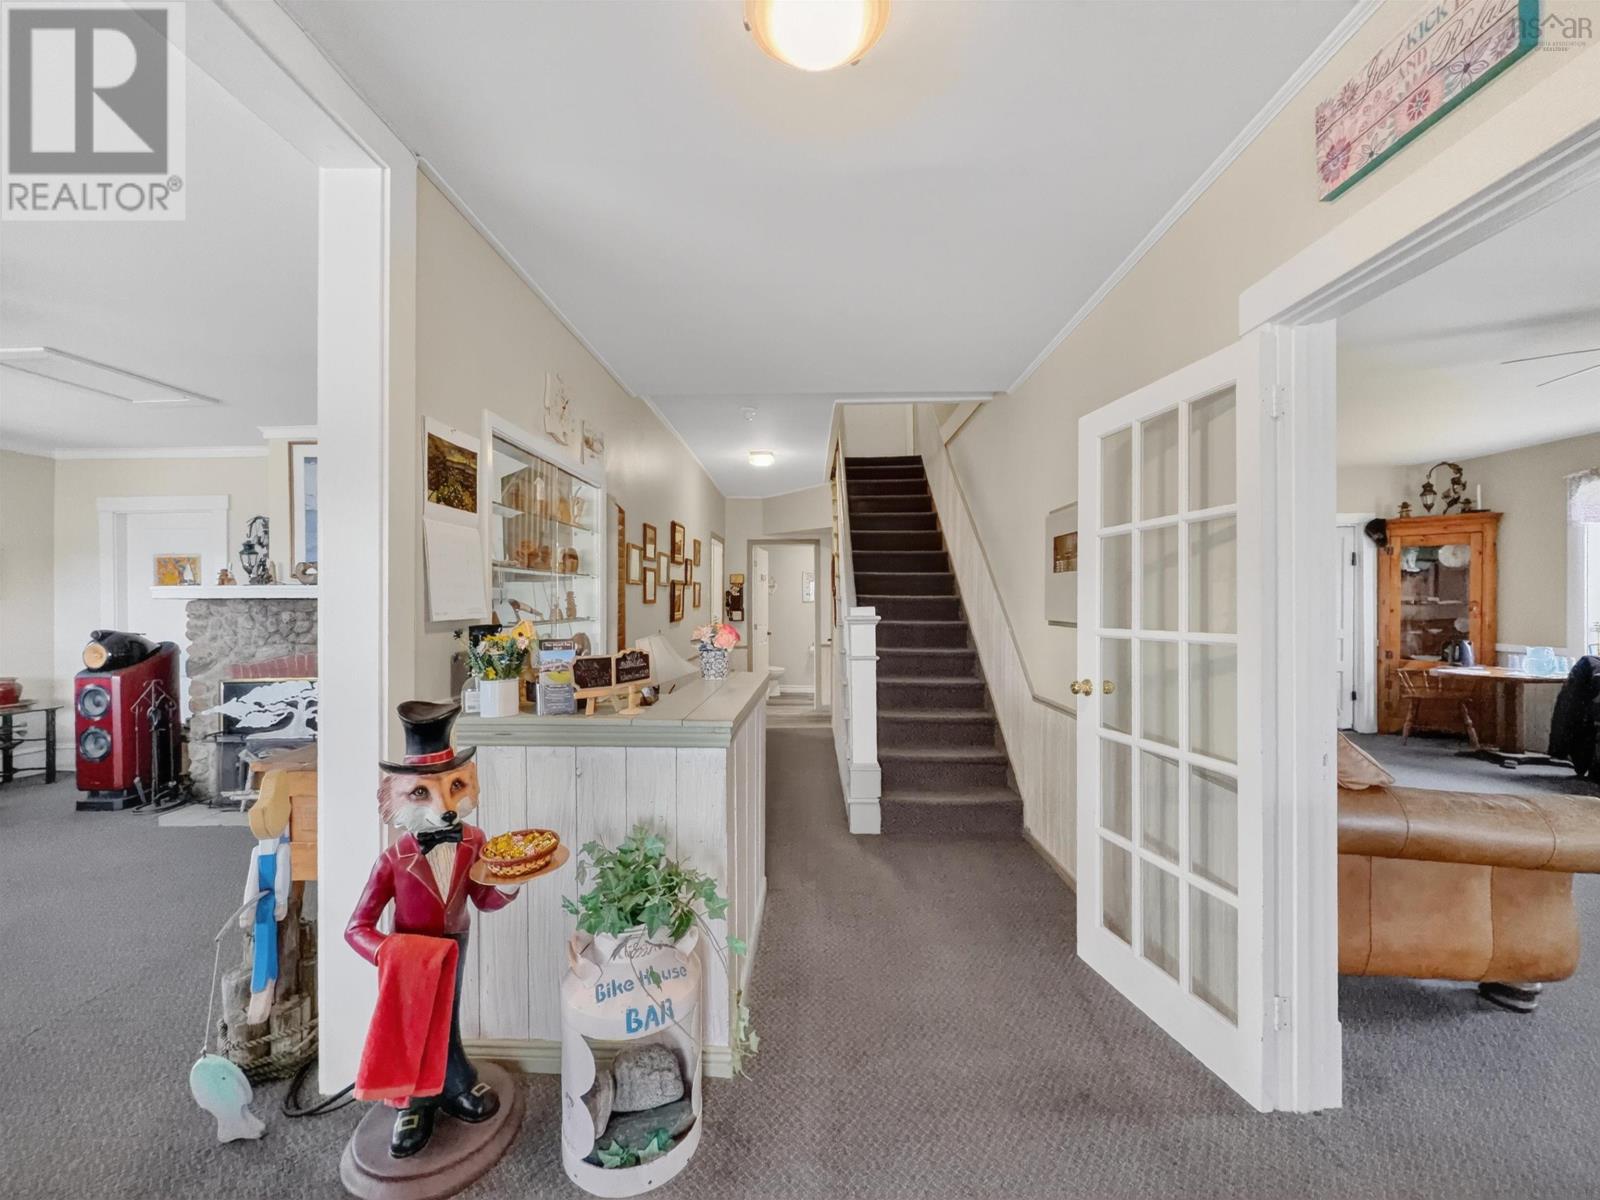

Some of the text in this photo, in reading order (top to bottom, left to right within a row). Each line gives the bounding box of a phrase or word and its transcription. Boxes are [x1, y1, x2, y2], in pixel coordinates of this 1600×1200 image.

[1406, 5, 1448, 50] KICK
[595, 966, 688, 1004] Bike Huse
[625, 998, 674, 1034] BAR
